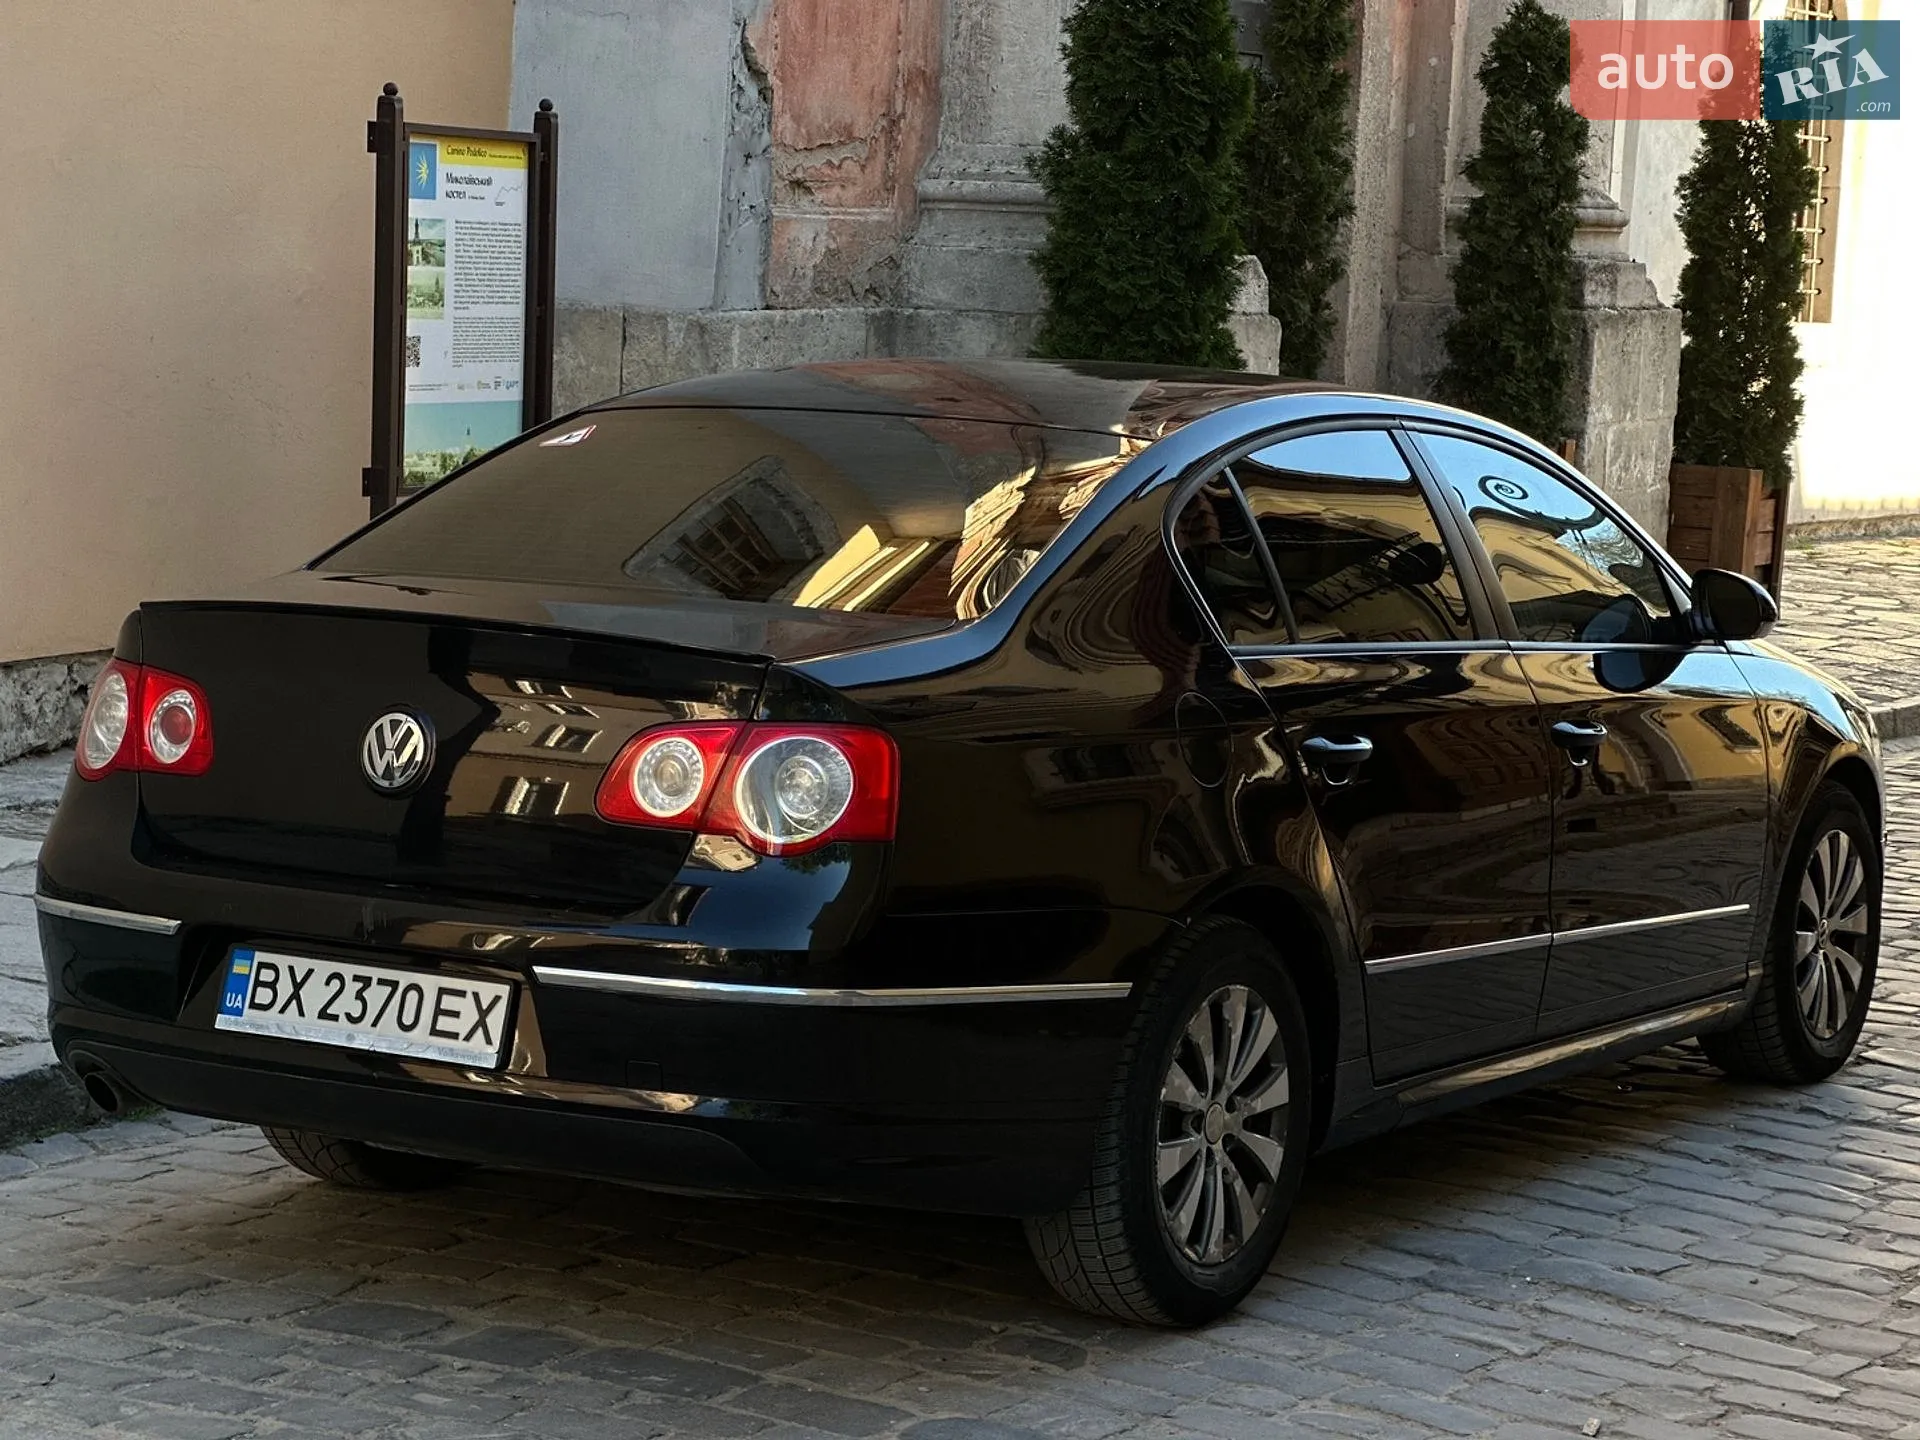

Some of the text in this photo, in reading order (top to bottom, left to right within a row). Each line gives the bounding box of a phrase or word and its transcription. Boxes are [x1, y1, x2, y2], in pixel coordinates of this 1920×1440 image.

[225, 991, 243, 1009] UA
[248, 961, 502, 1047] BX 2370 EX
